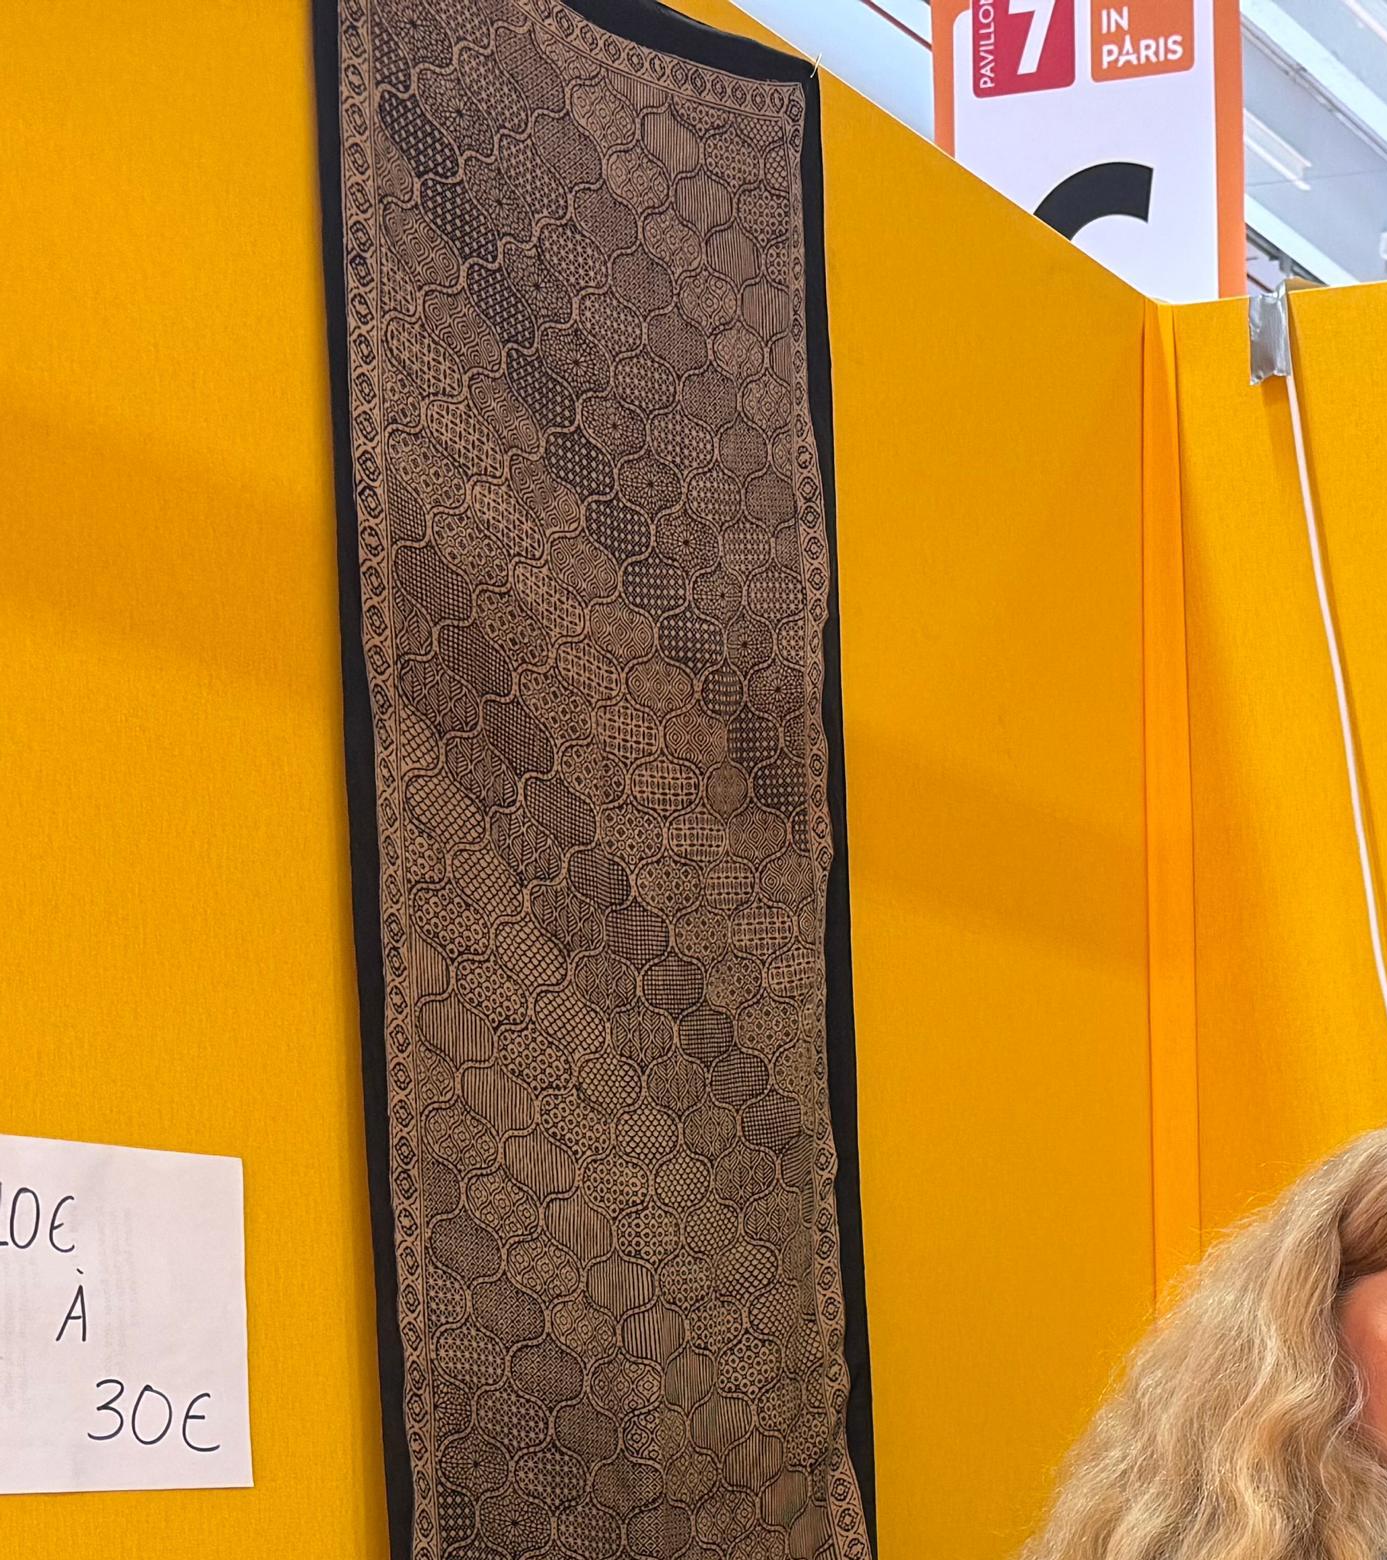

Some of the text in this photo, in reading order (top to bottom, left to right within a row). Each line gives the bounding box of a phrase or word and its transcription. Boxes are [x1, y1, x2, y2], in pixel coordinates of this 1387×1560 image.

[979, 0, 995, 88] PAVILLO
[1008, 0, 1056, 75] 7
[1101, 6, 1129, 34] IN
[1102, 35, 1184, 69] PARIS
[55, 1268, 87, 1342] À
[88, 1379, 220, 1452] 30€
